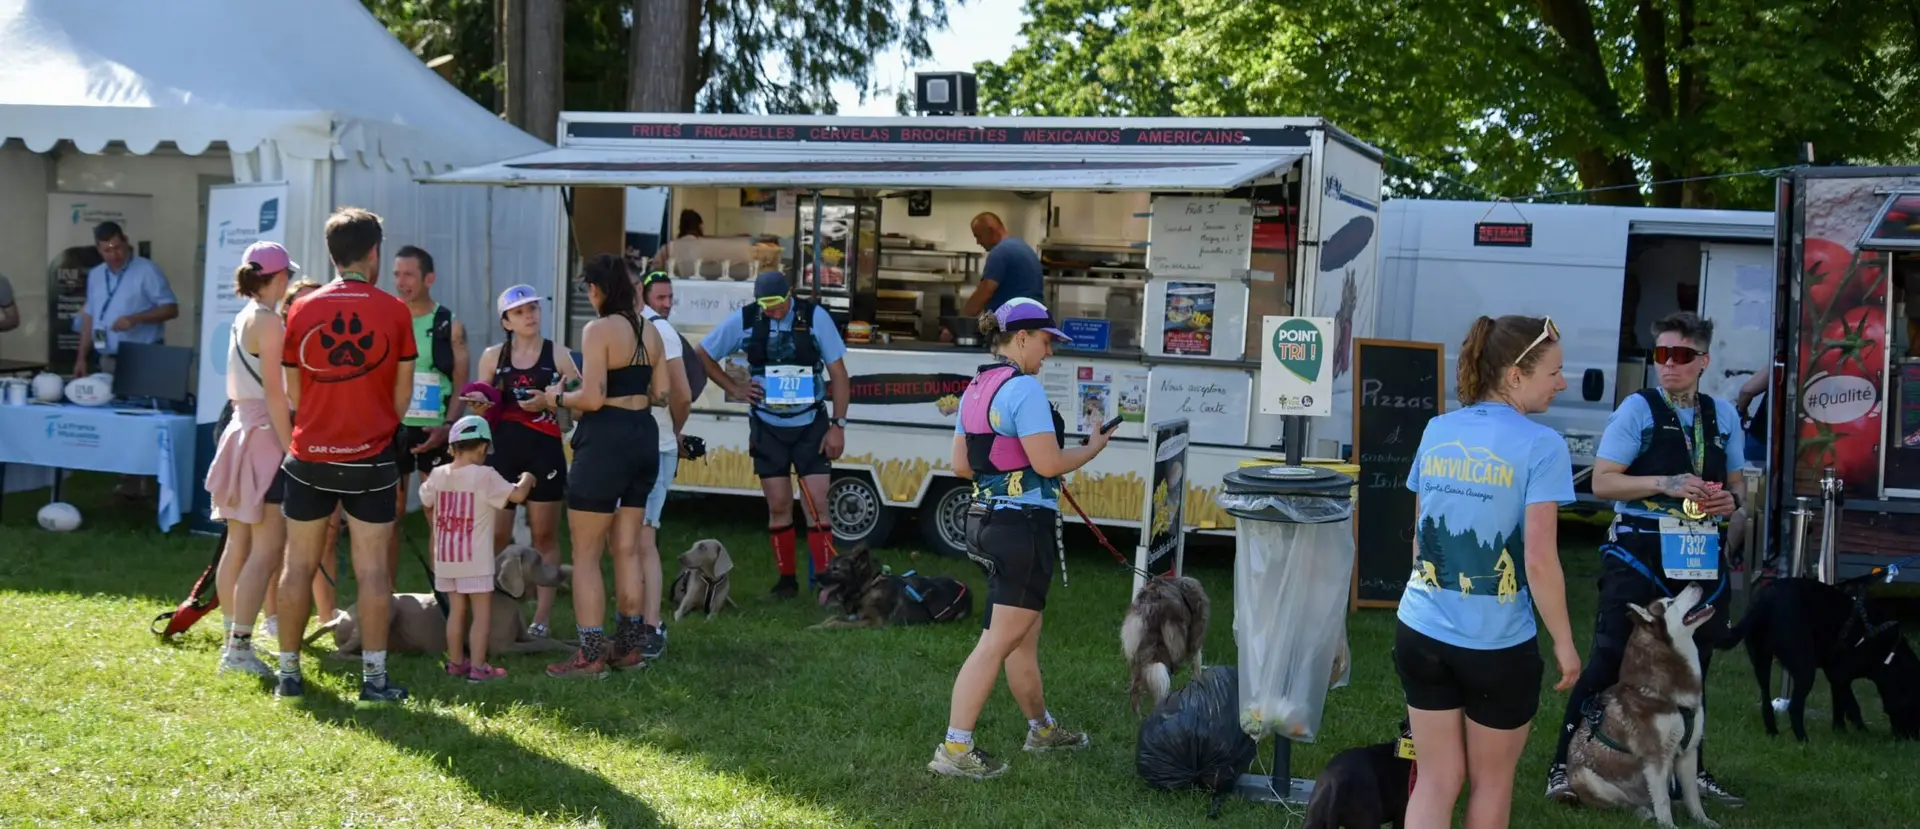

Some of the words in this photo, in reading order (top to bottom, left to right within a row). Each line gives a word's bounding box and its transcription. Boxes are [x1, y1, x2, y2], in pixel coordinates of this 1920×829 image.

[631, 124, 682, 137] FRITES
[695, 125, 796, 139] FRICADELLES
[810, 127, 891, 141] CERVELAS
[901, 128, 1007, 142] BROCHETTES
[1023, 129, 1121, 143] MEXICANOS
[1137, 130, 1244, 144] AMERICAINS
[1279, 330, 1318, 342] POINT
[1279, 343, 1306, 361] TRI
[1310, 344, 1317, 361] !
[779, 377, 801, 390] 7217
[885, 382, 920, 396] FRITE
[923, 381, 940, 395] DU
[943, 381, 970, 394] NOR
[1161, 379, 1184, 392] Nous
[1361, 379, 1434, 410] Pizzas
[1807, 386, 1872, 408] #Qualité
[308, 446, 328, 454] CAR
[1679, 534, 1707, 556] 7332
